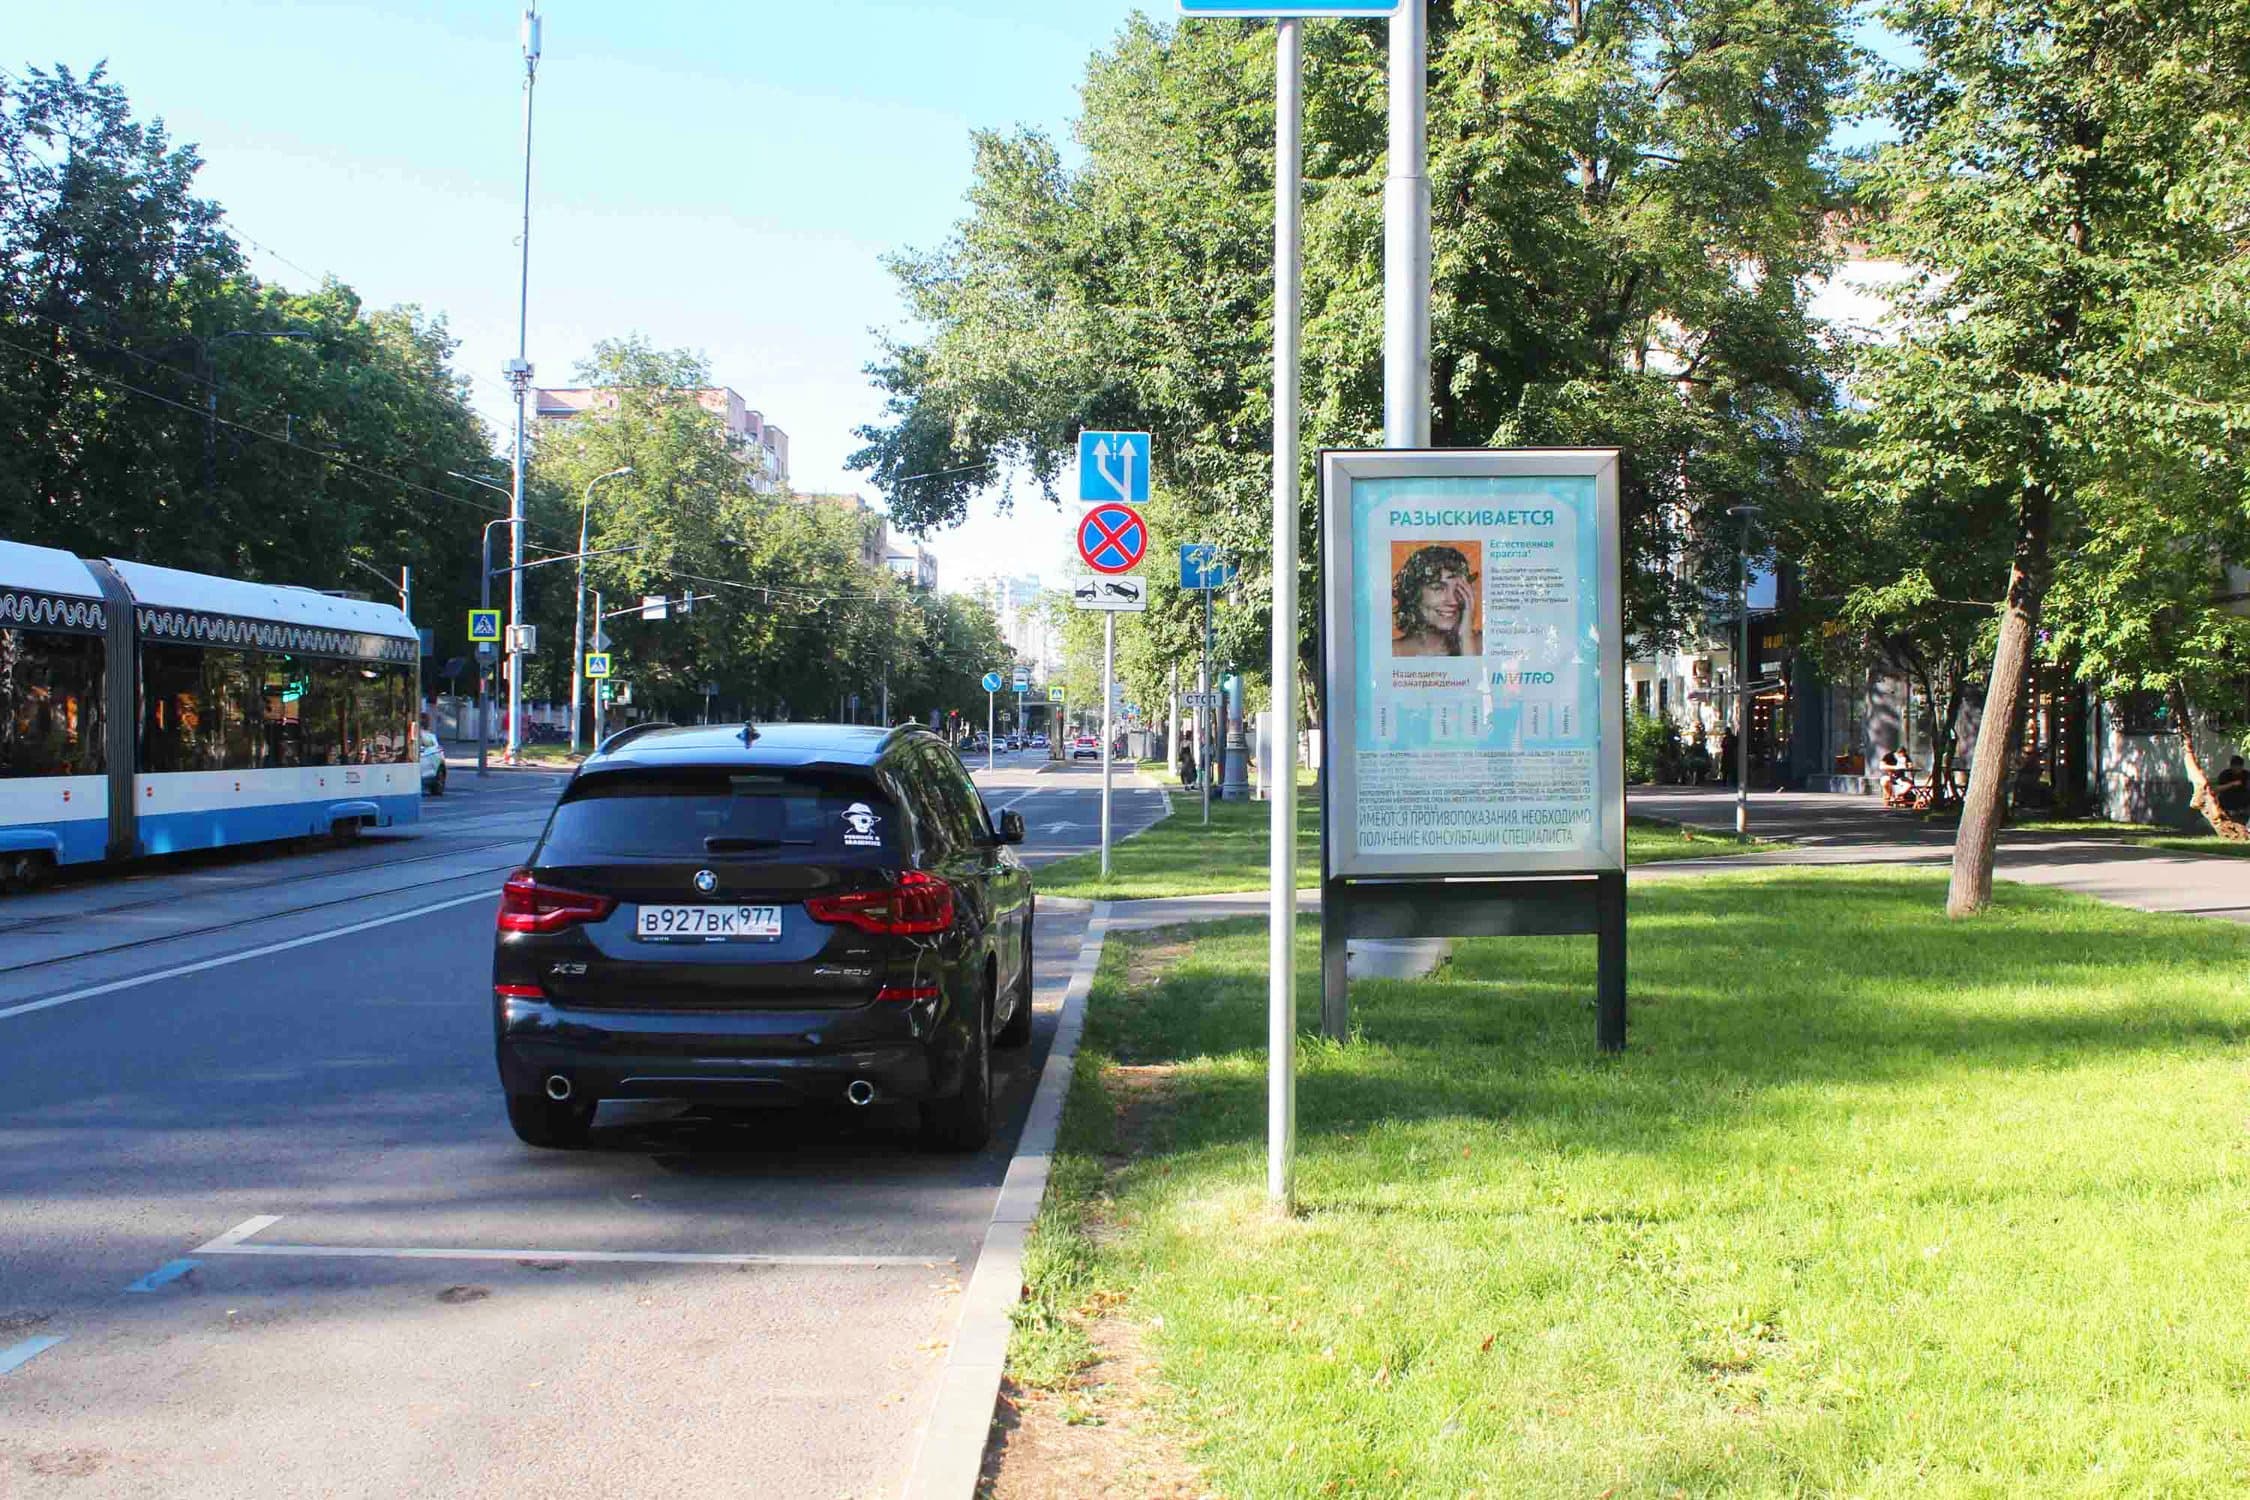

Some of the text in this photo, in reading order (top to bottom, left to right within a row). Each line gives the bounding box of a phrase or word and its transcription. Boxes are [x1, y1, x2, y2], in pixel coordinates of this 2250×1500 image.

[1389, 510, 1554, 526] РАЗЫСКИВАЕТСЯ
[1491, 671, 1555, 685] INVITRO
[1360, 811, 1408, 826] ИМЕЮТСЯ
[1521, 808, 1591, 825] НЕОБХОДИМО
[1360, 830, 1420, 846] ПОЛУЧЕНИЕ
[1422, 829, 1500, 846] КОНСУЛЬТАЦИИ
[740, 908, 774, 925] 977
